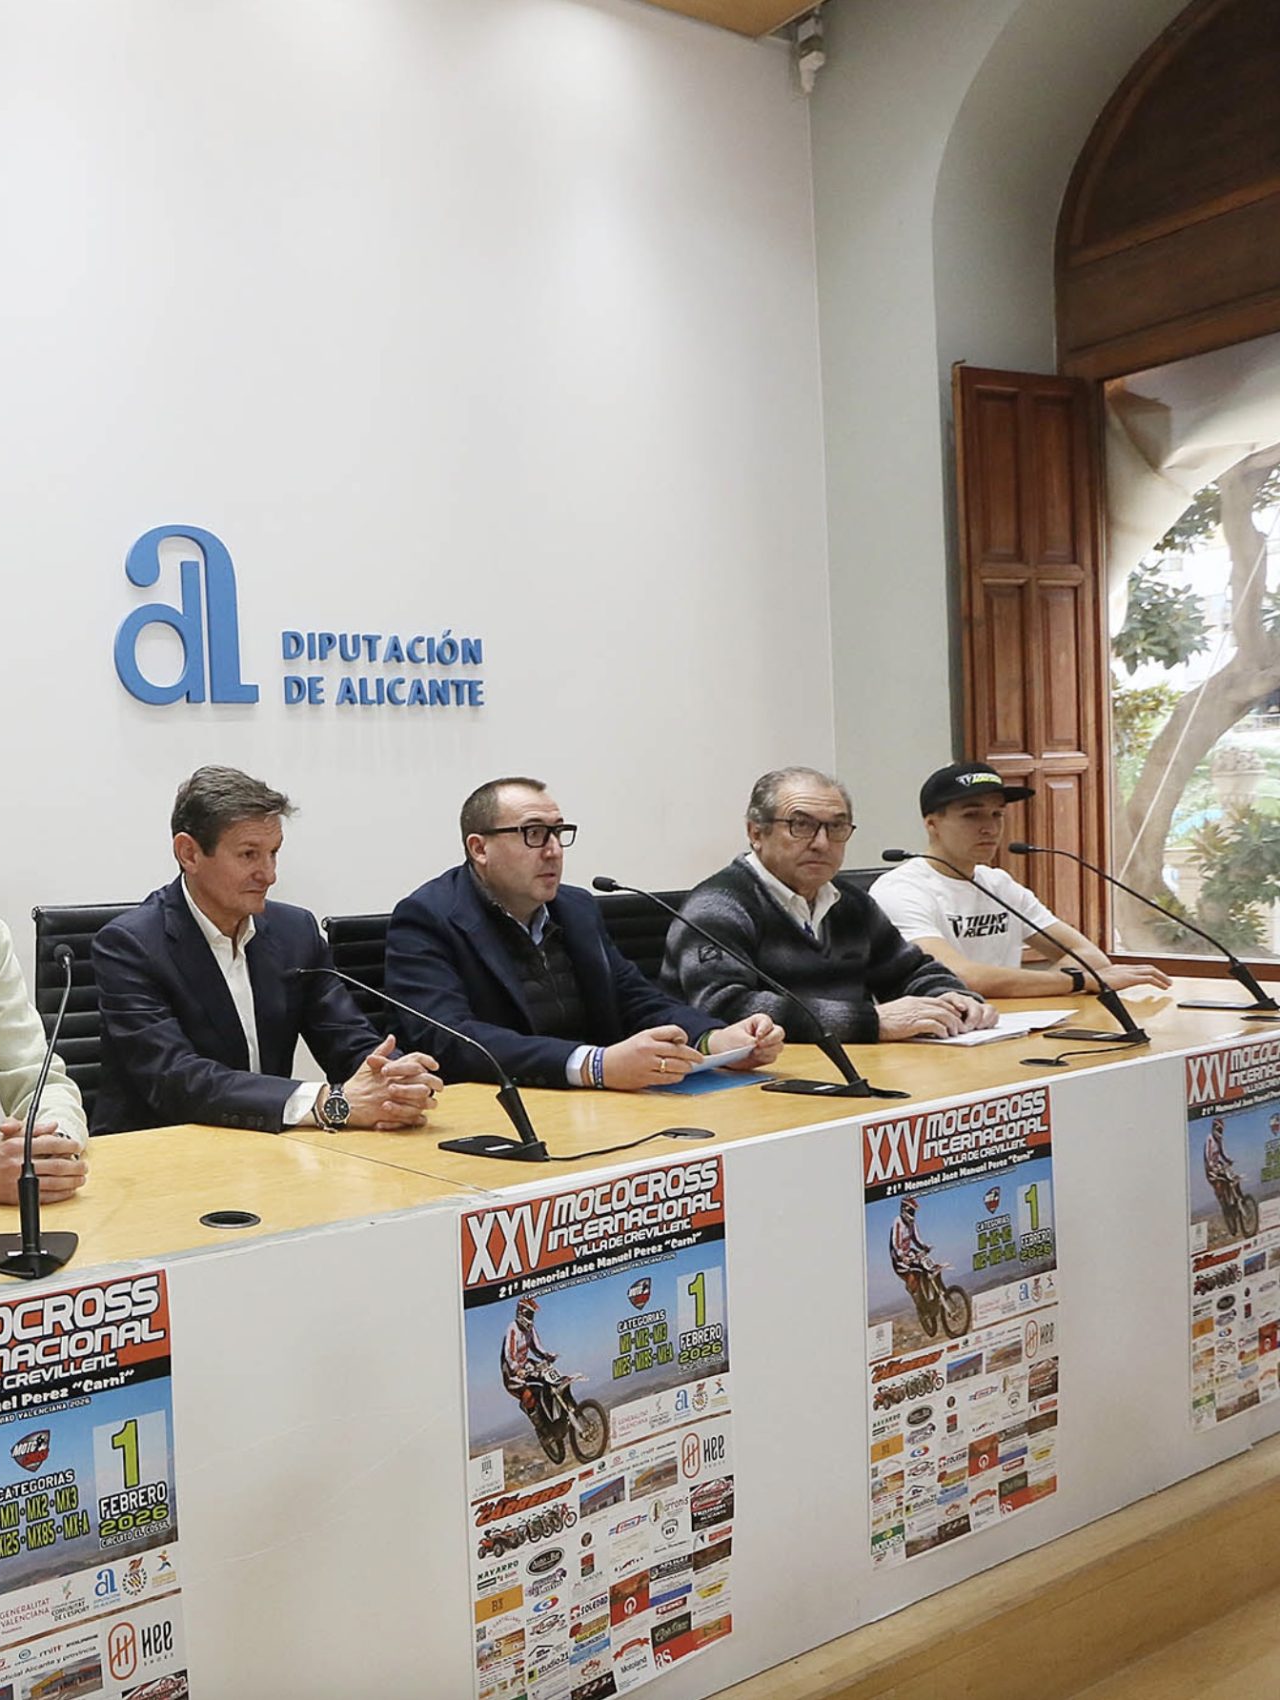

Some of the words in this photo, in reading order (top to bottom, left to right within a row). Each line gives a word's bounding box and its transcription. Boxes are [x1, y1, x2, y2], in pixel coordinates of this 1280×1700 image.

[281, 629, 483, 665] DIPUTACIÓN
[284, 675, 325, 704] DE
[335, 677, 484, 707] ALICANTE
[1188, 1051, 1229, 1105] XXV
[866, 1117, 924, 1184] XXV
[925, 1090, 1046, 1140] MOTOCROSS
[923, 1115, 1048, 1160] INTERNACIONAL
[904, 1174, 940, 1191] Memorial
[959, 1163, 987, 1176] Manuel
[466, 1200, 550, 1285] XXV
[552, 1159, 718, 1227] MOTOCROSS
[547, 1191, 721, 1251] INTERNACIONAL
[1024, 1184, 1039, 1230] 1
[574, 1240, 607, 1258] VILLA
[608, 1236, 624, 1249] DE
[624, 1218, 691, 1245] CREVILLENT
[522, 1267, 569, 1290] Memorial
[571, 1260, 596, 1276] Jose
[597, 1250, 632, 1268] Manuel
[634, 1244, 663, 1260] Perez
[688, 1272, 706, 1327] 1
[617, 1309, 666, 1333] CATEGORIAS
[680, 1323, 723, 1350] FEBRERO
[679, 1341, 723, 1365] 2026
[3, 1352, 118, 1391] CREVILLENT
[18, 1402, 68, 1421] VALENCIANA
[69, 1397, 91, 1409] 2026
[21, 1386, 69, 1408] Perez
[112, 1418, 140, 1488] 1
[26, 1493, 50, 1522] MX2
[54, 1487, 78, 1515] MX3
[99, 1481, 167, 1519] FEBRERO
[26, 1521, 56, 1550] MX85
[99, 1504, 170, 1536] 2026
[0, 1597, 50, 1620] GENERALITAT
[0, 1607, 50, 1628] VALENCIANA
[25, 1660, 55, 1674] Alicante
[62, 1646, 97, 1662] provincia
